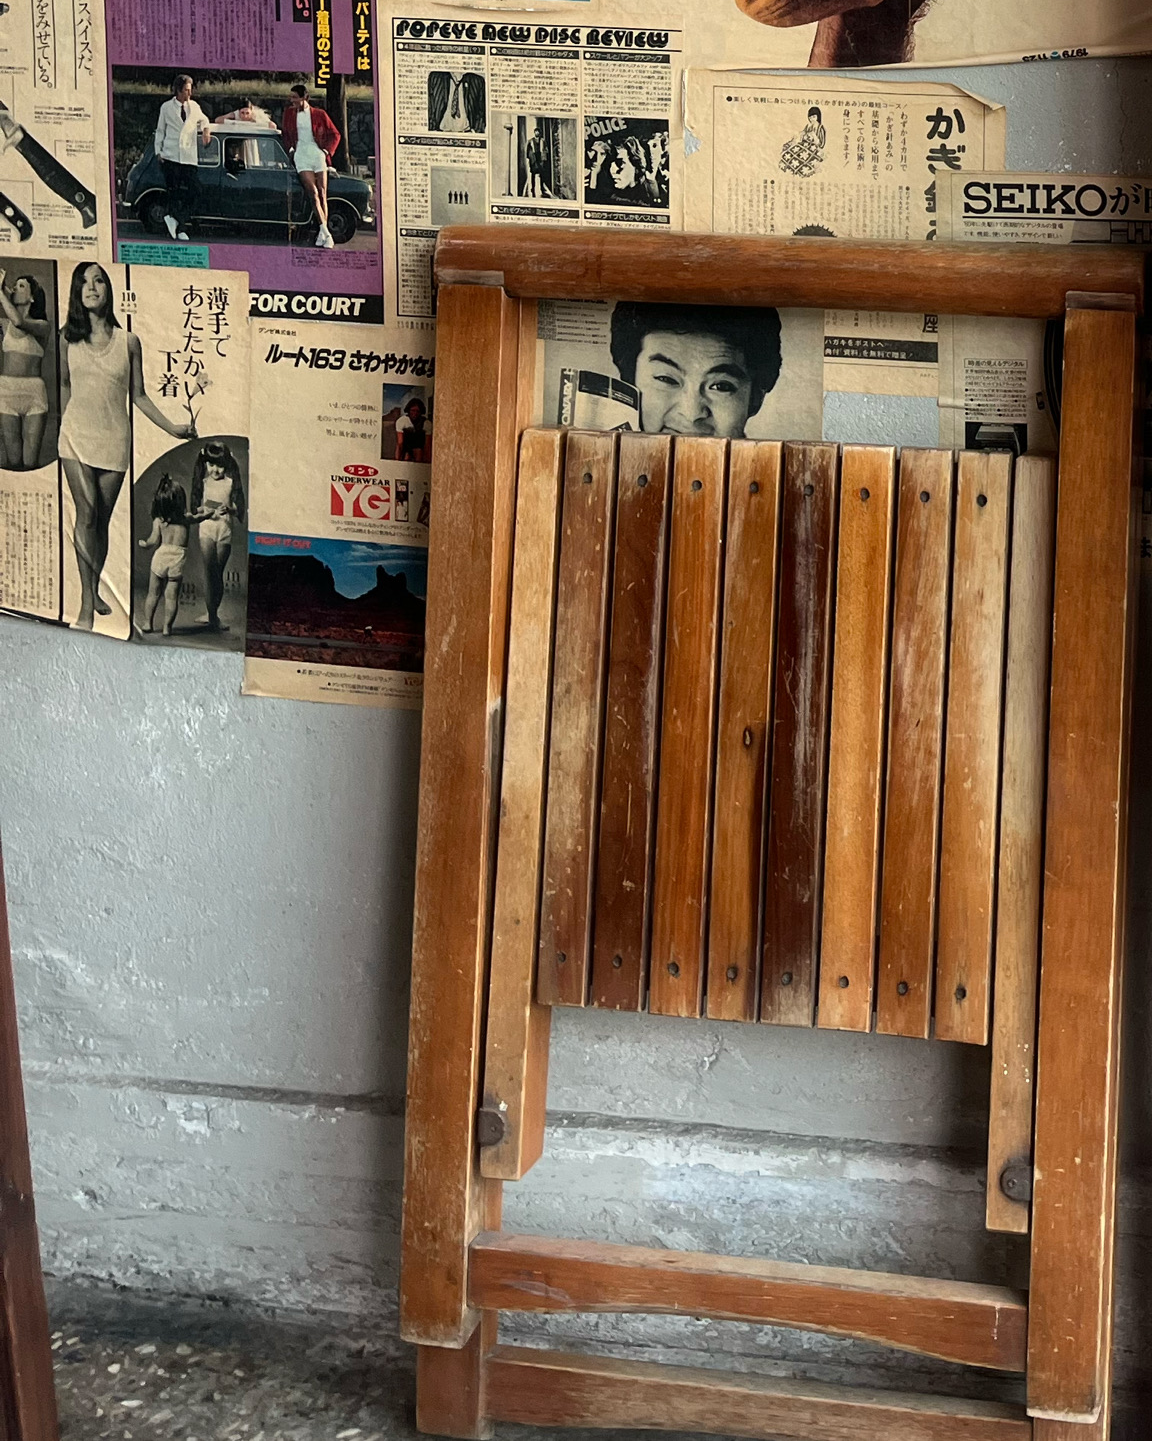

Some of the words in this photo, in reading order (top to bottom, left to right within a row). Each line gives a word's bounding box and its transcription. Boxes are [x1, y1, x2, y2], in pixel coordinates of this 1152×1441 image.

[395, 19, 478, 41] POPEYE
[535, 26, 581, 45] DISC
[586, 28, 669, 49] REVIEW
[584, 117, 628, 141] POLICE
[248, 294, 287, 314] FOR
[290, 296, 366, 317] COURT
[206, 285, 230, 358] 薄手で
[182, 285, 206, 398] あたたかい
[264, 343, 346, 370] ルート163
[157, 350, 181, 398] 下着
[330, 475, 391, 486] UNDERWEAR
[331, 483, 391, 521] YG
